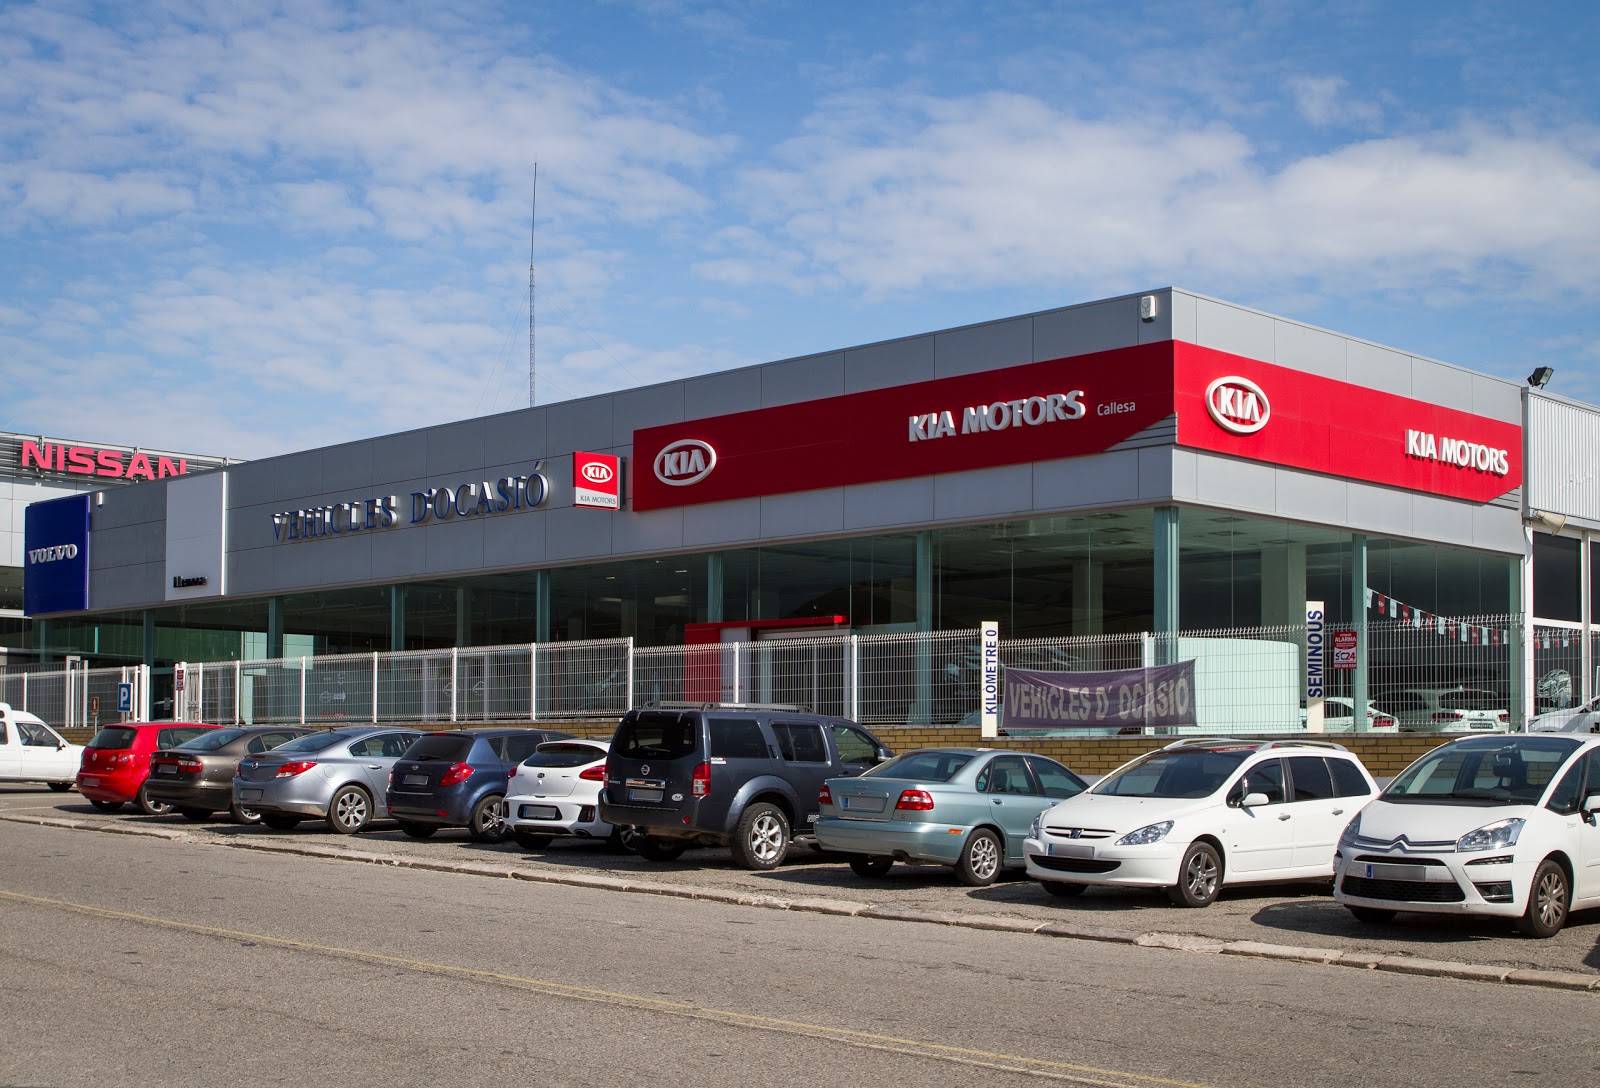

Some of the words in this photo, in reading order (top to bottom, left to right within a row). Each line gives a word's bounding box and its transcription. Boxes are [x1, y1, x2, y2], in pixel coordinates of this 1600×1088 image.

[908, 410, 956, 442] KIA
[962, 390, 1086, 435] MOTORS
[1097, 400, 1136, 417] Callesa
[1217, 385, 1260, 422] KIA
[21, 440, 187, 480] NISSAN
[664, 449, 706, 477] KIA
[1405, 429, 1437, 460] KIA
[1438, 437, 1509, 475] MOTORS
[270, 495, 397, 542] VEHICLES
[410, 460, 549, 524] D'OCASIÓ
[580, 495, 591, 503] KIA
[592, 496, 616, 505] MOTORS
[28, 543, 78, 564] VOLVO
[1307, 610, 1323, 698] SEMINOUS
[120, 687, 129, 707] P
[985, 641, 997, 715] KILOMETRE
[1009, 682, 1091, 721] VEHICLES
